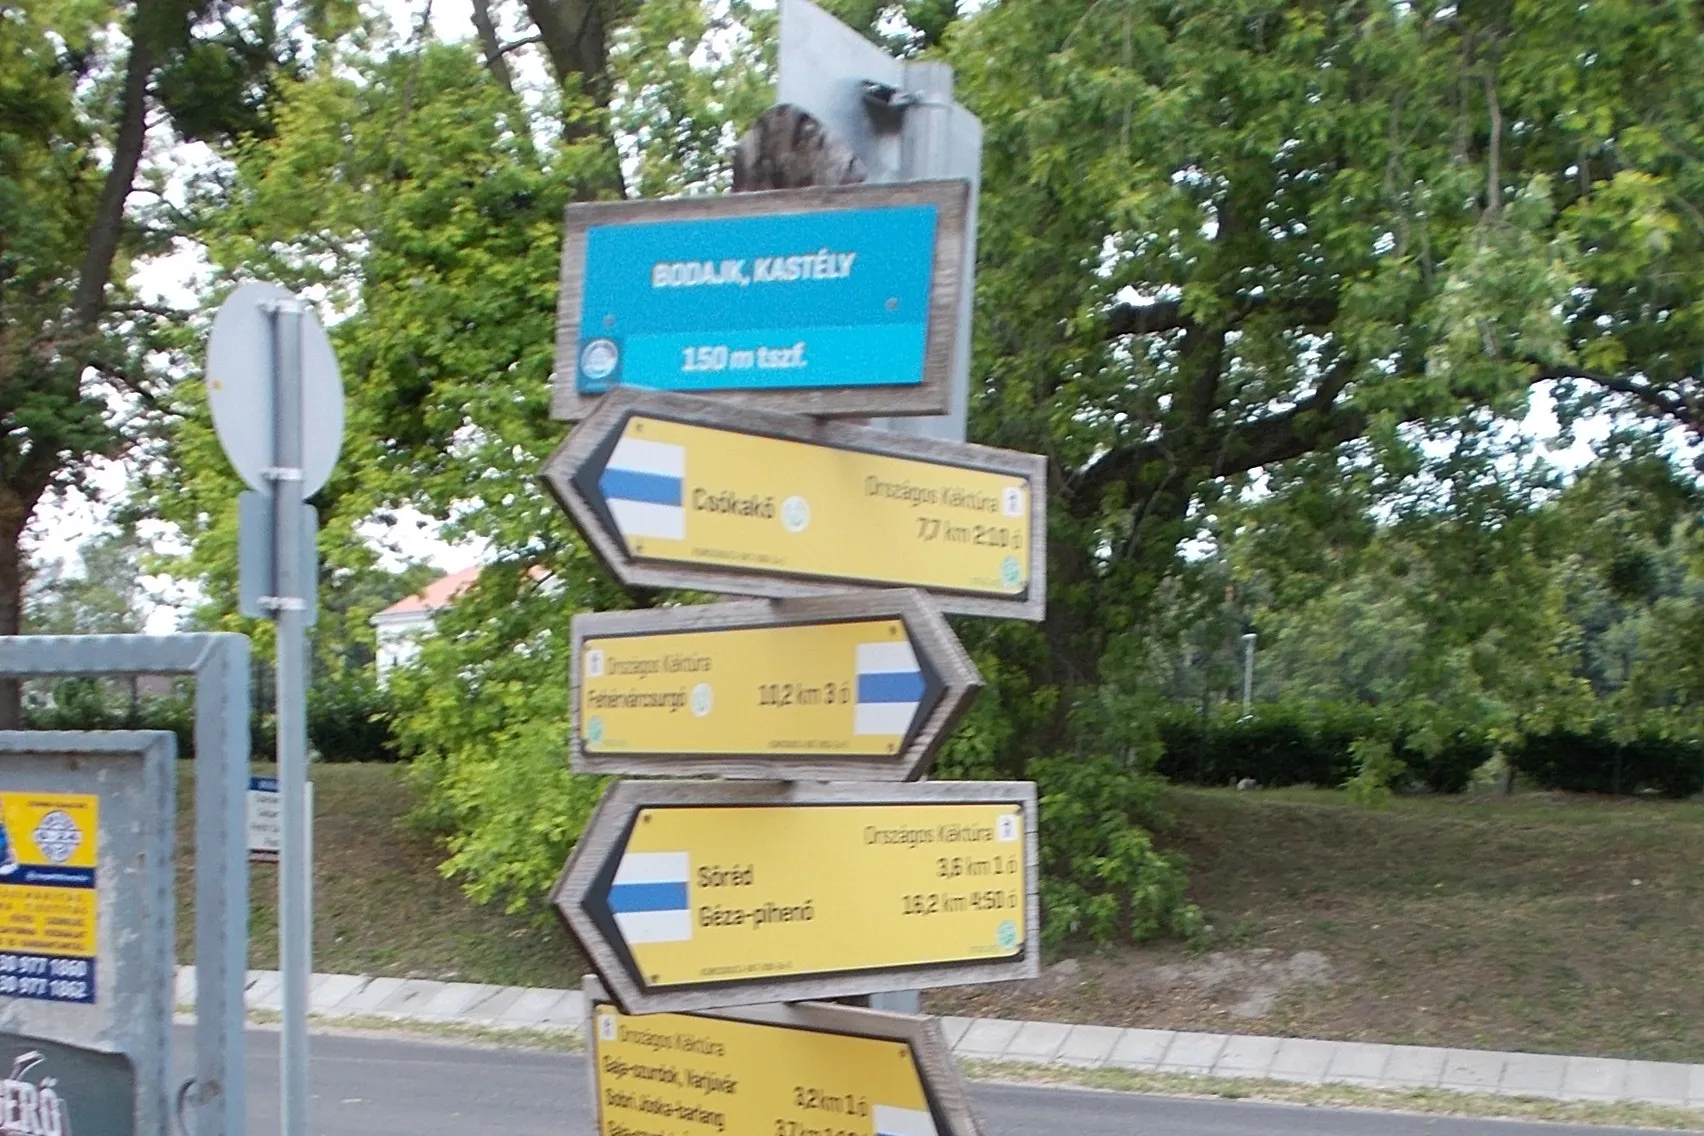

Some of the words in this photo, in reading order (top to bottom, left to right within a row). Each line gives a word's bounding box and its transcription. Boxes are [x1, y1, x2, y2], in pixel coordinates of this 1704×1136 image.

[651, 259, 750, 288] BODAJK,
[753, 248, 856, 283] KASTÉLY
[682, 346, 728, 373] 150
[729, 351, 753, 369] m
[757, 341, 807, 370] tszf.
[864, 474, 938, 507] Országos
[942, 486, 999, 513] Kéktúra
[944, 521, 970, 543] km
[796, 683, 821, 705] km
[863, 824, 935, 849] Országos
[967, 855, 990, 875] km
[993, 855, 1003, 875] 1
[942, 892, 967, 913] km
[819, 1089, 844, 1112] km
